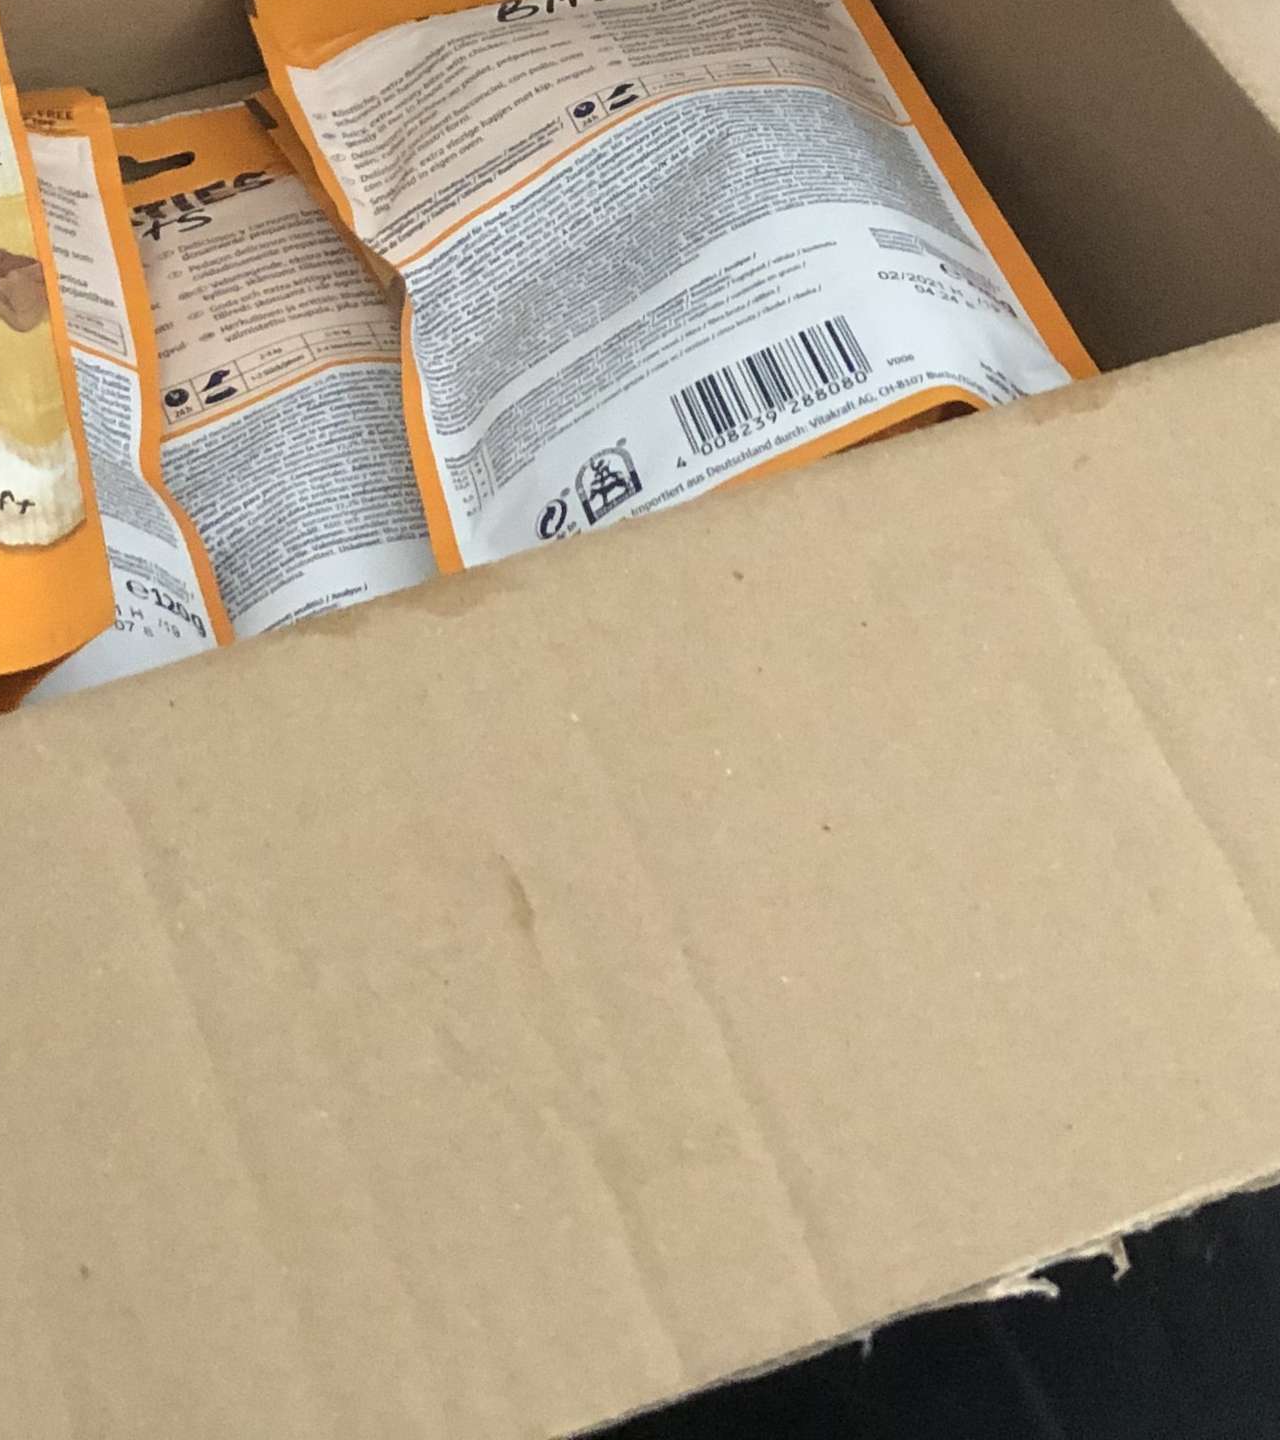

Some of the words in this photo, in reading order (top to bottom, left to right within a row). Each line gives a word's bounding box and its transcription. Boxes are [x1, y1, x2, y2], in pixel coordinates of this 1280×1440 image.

[676, 456, 687, 469] 4
[701, 410, 777, 456] 008239
[789, 371, 869, 414] 288080
[686, 472, 706, 489] aus
[705, 439, 774, 478] Deutschland
[773, 423, 808, 447] durch:
[808, 401, 857, 430] Vitakraft
